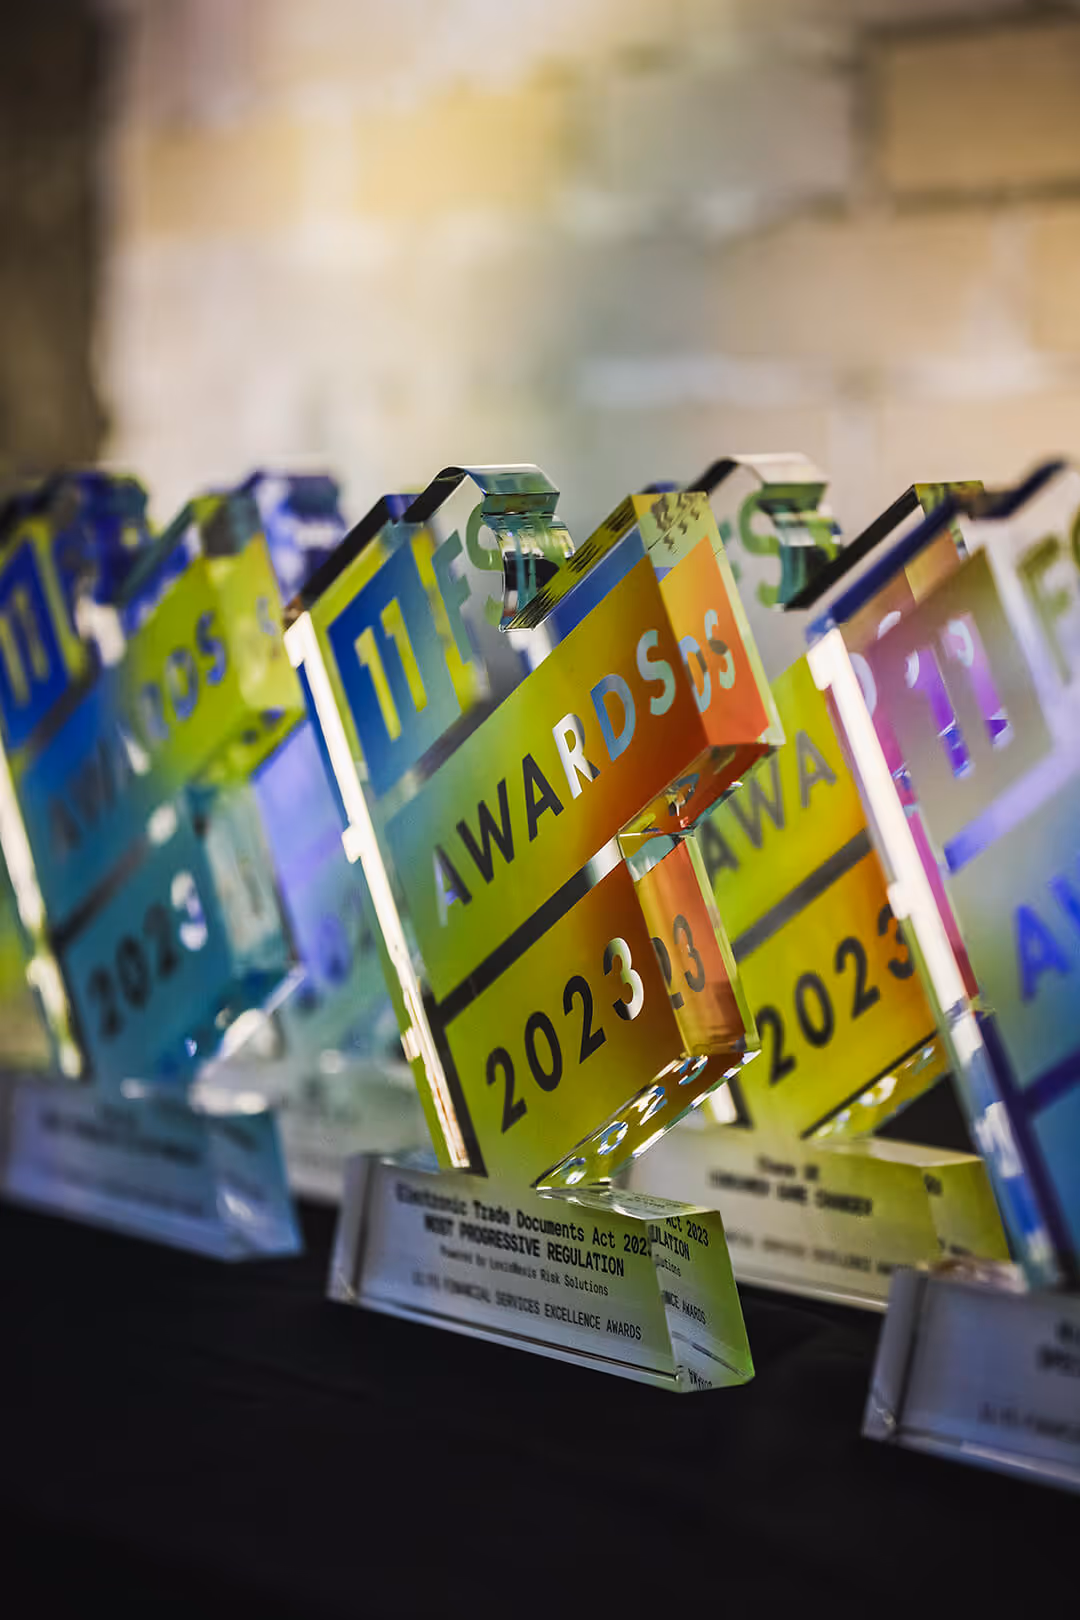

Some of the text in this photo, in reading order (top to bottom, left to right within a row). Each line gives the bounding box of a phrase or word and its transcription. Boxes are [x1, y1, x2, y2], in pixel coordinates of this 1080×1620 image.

[433, 630, 675, 927] AWARDS
[756, 904, 914, 1086] 2023
[486, 937, 644, 1134] 2023
[459, 1221, 541, 1258] PROGRESSIVE
[547, 1241, 624, 1277] REGULATION
[473, 1200, 510, 1225] Trade
[517, 1209, 584, 1242] Documents
[592, 1227, 616, 1249] Act
[687, 1220, 709, 1247] 2023
[540, 1268, 561, 1282] Risk
[564, 1274, 608, 1296] Solutions
[495, 1290, 540, 1315] SERVICES
[544, 1303, 600, 1330] EXCELLENCE
[606, 1319, 641, 1341] AWARDS
